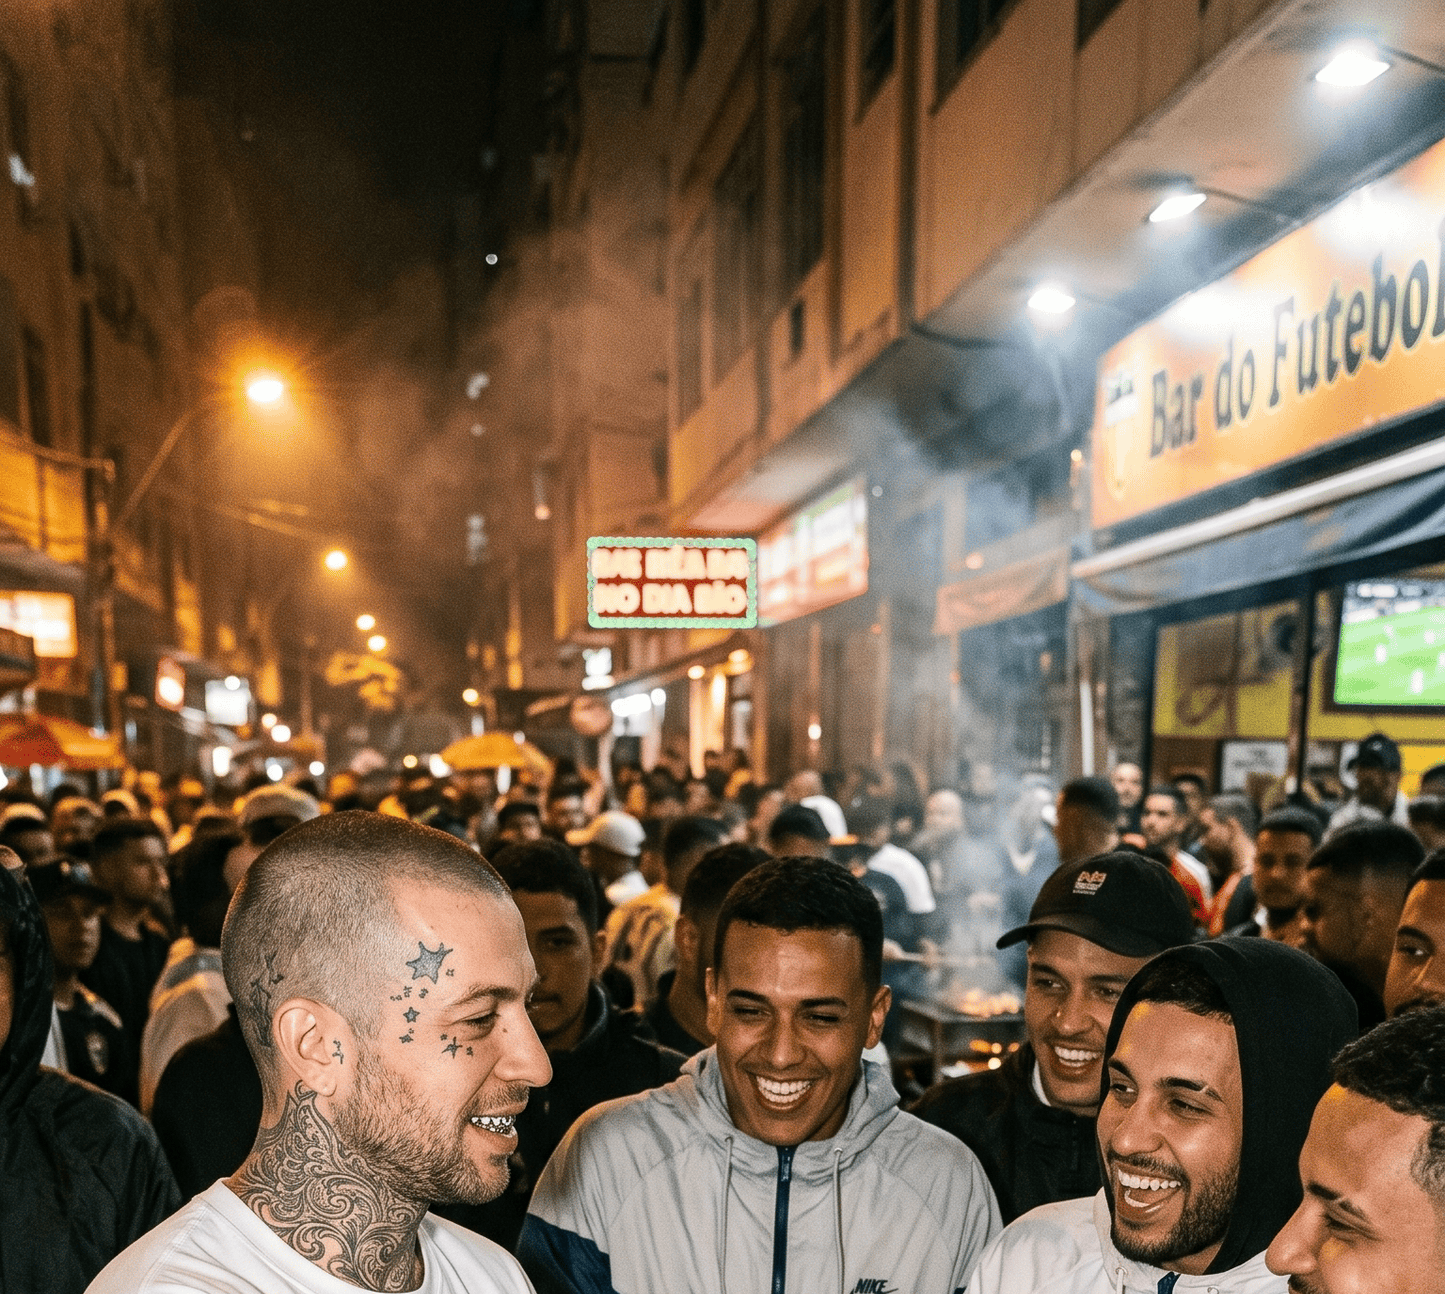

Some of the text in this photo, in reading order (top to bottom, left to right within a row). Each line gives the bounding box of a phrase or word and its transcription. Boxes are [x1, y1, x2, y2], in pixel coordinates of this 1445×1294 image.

[1150, 368, 1205, 459] Bar
[1215, 331, 1256, 431] do
[854, 1278, 889, 1294] NIKE
